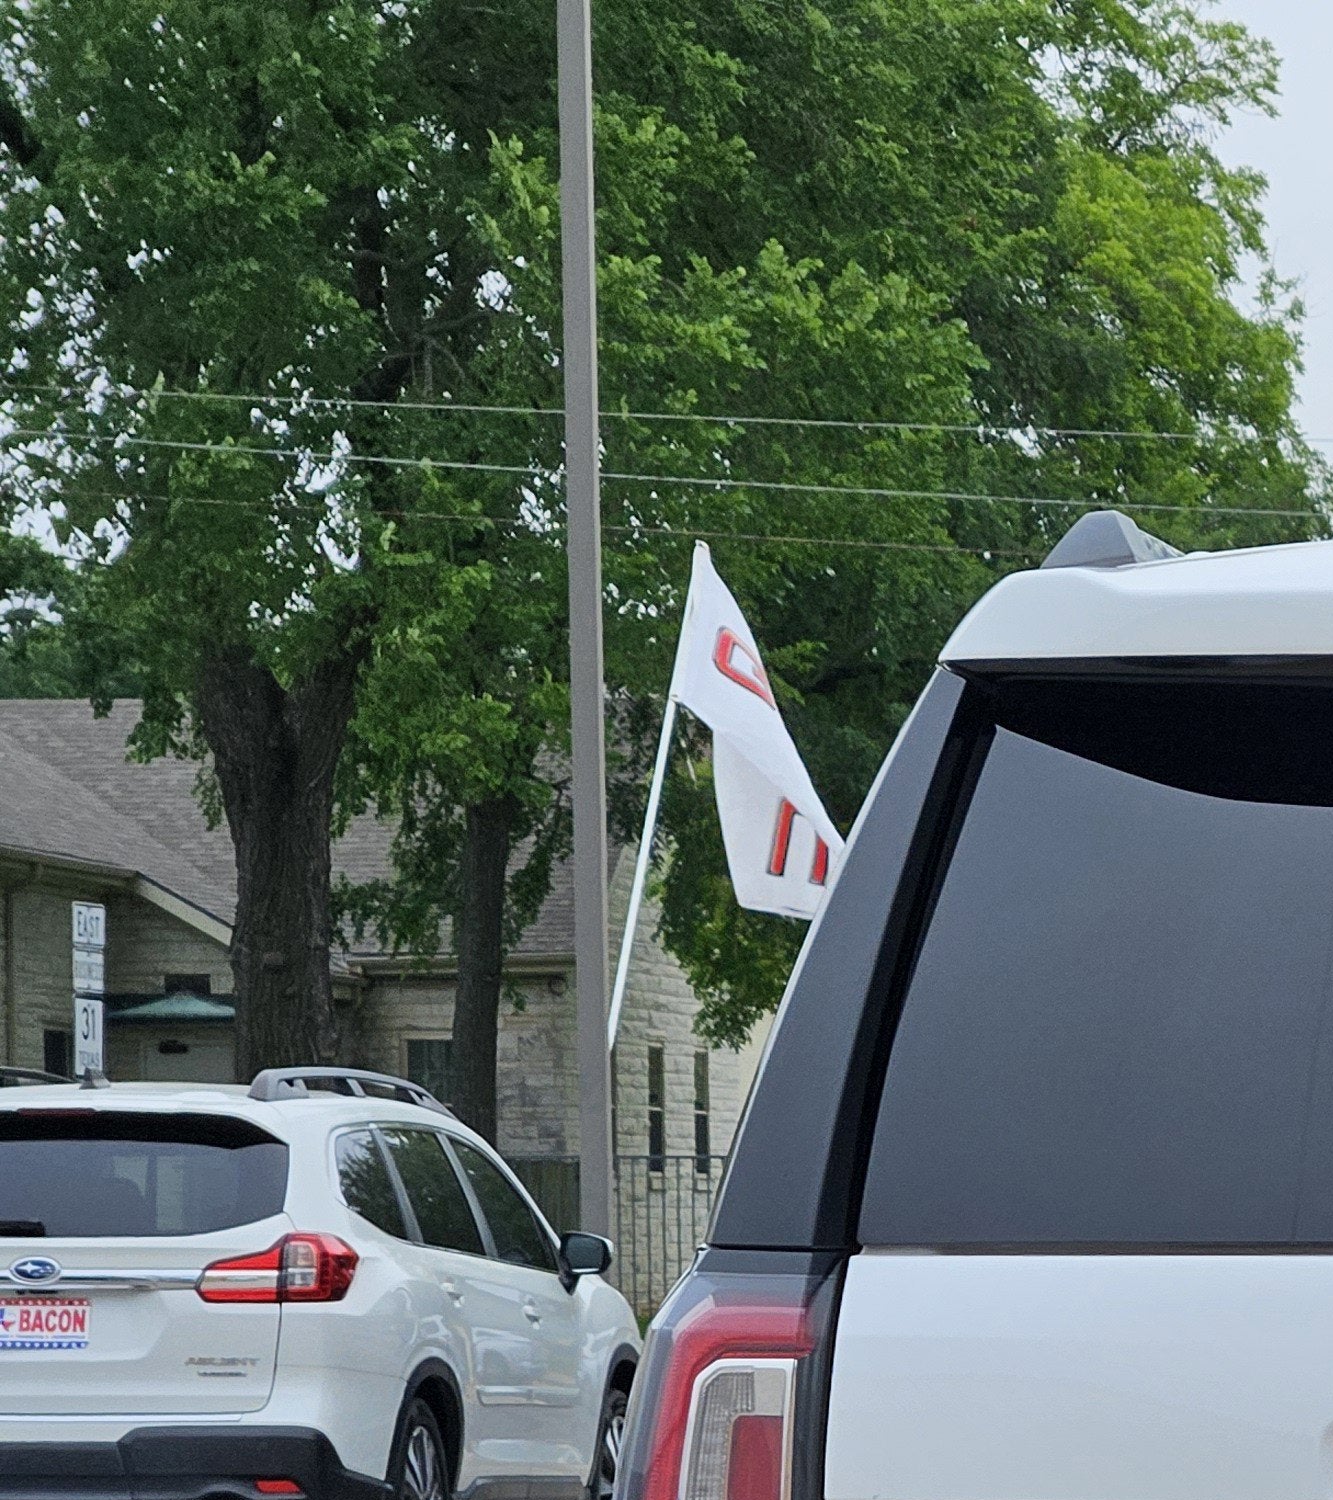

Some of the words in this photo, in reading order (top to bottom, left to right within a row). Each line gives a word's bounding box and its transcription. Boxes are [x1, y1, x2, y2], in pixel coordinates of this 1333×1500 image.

[77, 911, 101, 938] EAST
[82, 1006, 96, 1041] 31
[18, 1308, 86, 1333] BACON
